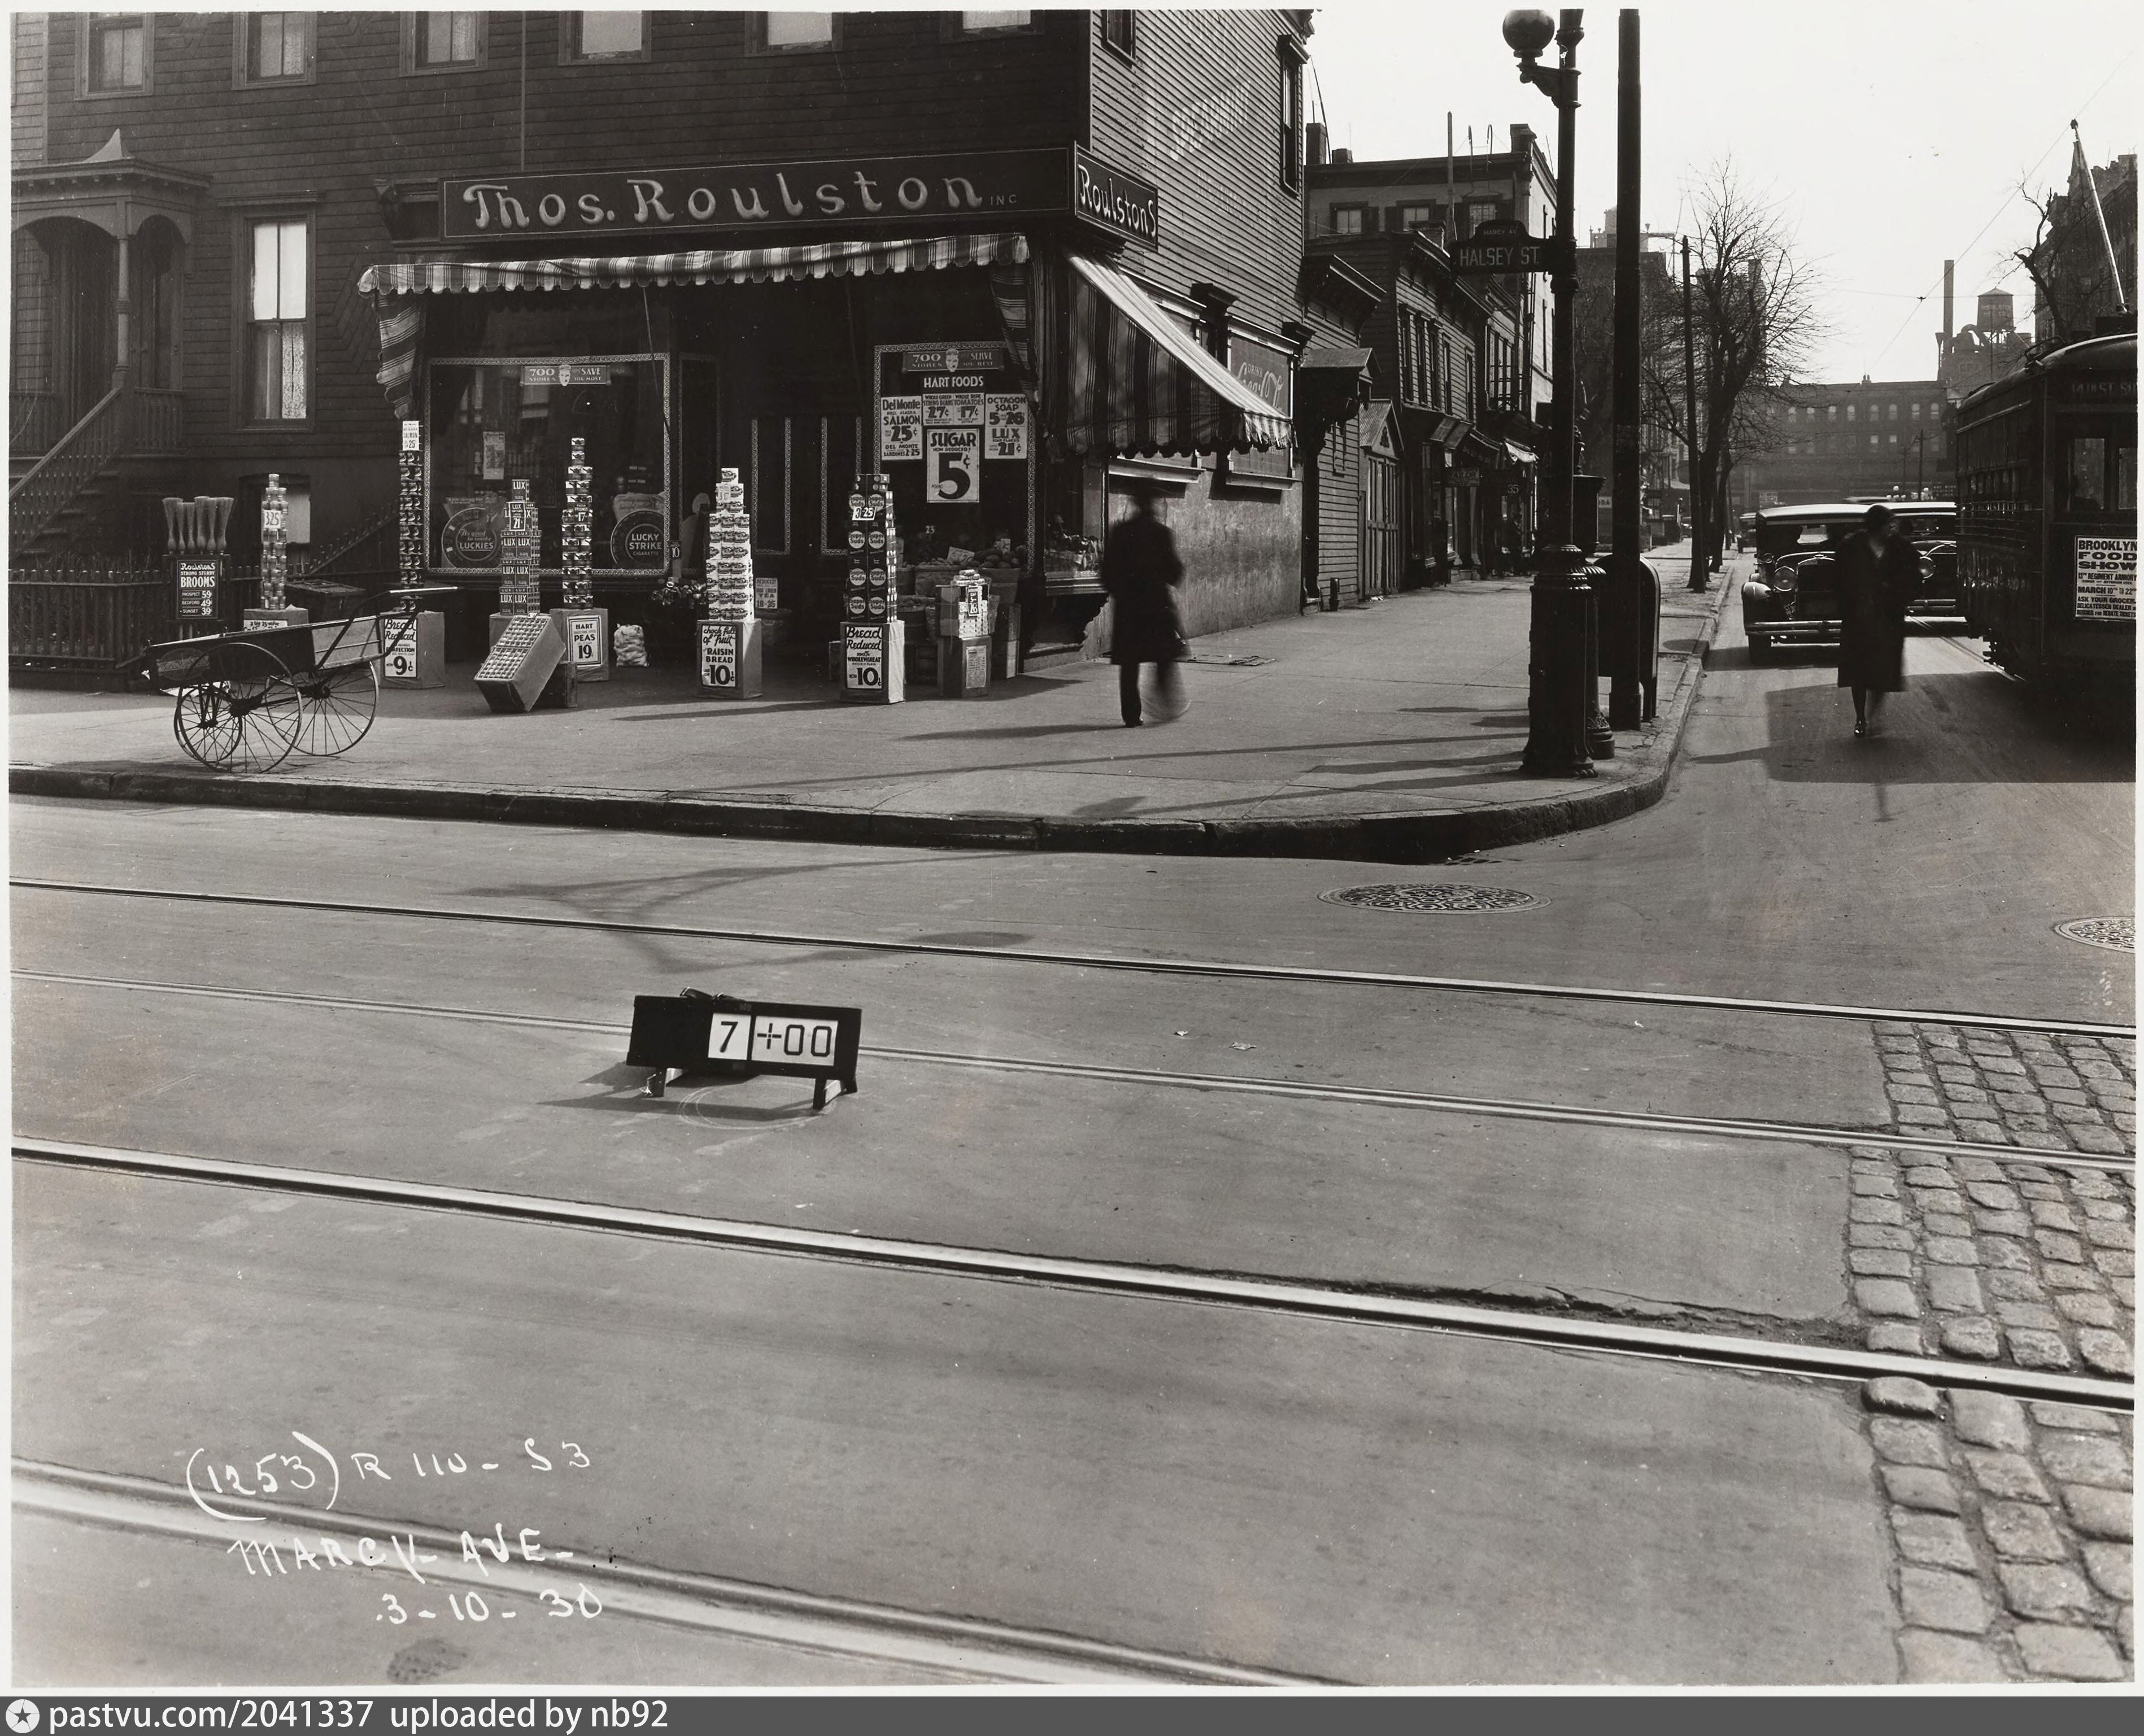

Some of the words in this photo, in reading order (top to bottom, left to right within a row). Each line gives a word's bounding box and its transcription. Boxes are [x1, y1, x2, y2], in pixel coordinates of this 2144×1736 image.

[463, 184, 615, 229] Thos.
[627, 171, 982, 224] Roulston
[990, 193, 1018, 207] INC
[1459, 247, 1514, 267] HALSEY
[912, 353, 942, 363] 700
[970, 352, 993, 360] SERVE
[529, 368, 555, 377] 700
[923, 377, 949, 388] HART
[951, 376, 984, 387] FOODS
[995, 403, 1019, 412] SOAP
[883, 415, 921, 425] SALMON
[989, 412, 1000, 425] 5
[992, 428, 1021, 439] LUX
[930, 431, 977, 447] SUGAR
[513, 481, 526, 490] LUX
[1507, 483, 1519, 494] 35
[578, 512, 586, 522] 17
[503, 538, 516, 547] LUX
[518, 538, 530, 547] LUX
[631, 533, 660, 542] LUCKY
[629, 542, 663, 550] STRIKE
[2078, 540, 2137, 551] BROOKLYN
[672, 547, 681, 558] 10
[2078, 551, 2137, 561] FOOD
[502, 566, 515, 575] LUX
[517, 566, 529, 575] LUX
[2078, 561, 2137, 571] SHOW
[180, 576, 215, 588] BROOMS
[500, 594, 513, 603] LUX
[515, 594, 527, 603] LUX
[703, 625, 722, 635] chock
[847, 626, 882, 639] Bread
[703, 635, 713, 645] of
[713, 634, 737, 647] Fruit
[847, 639, 882, 651] Reduced
[186, 1430, 339, 1521] (1253)
[351, 1453, 391, 1480] R
